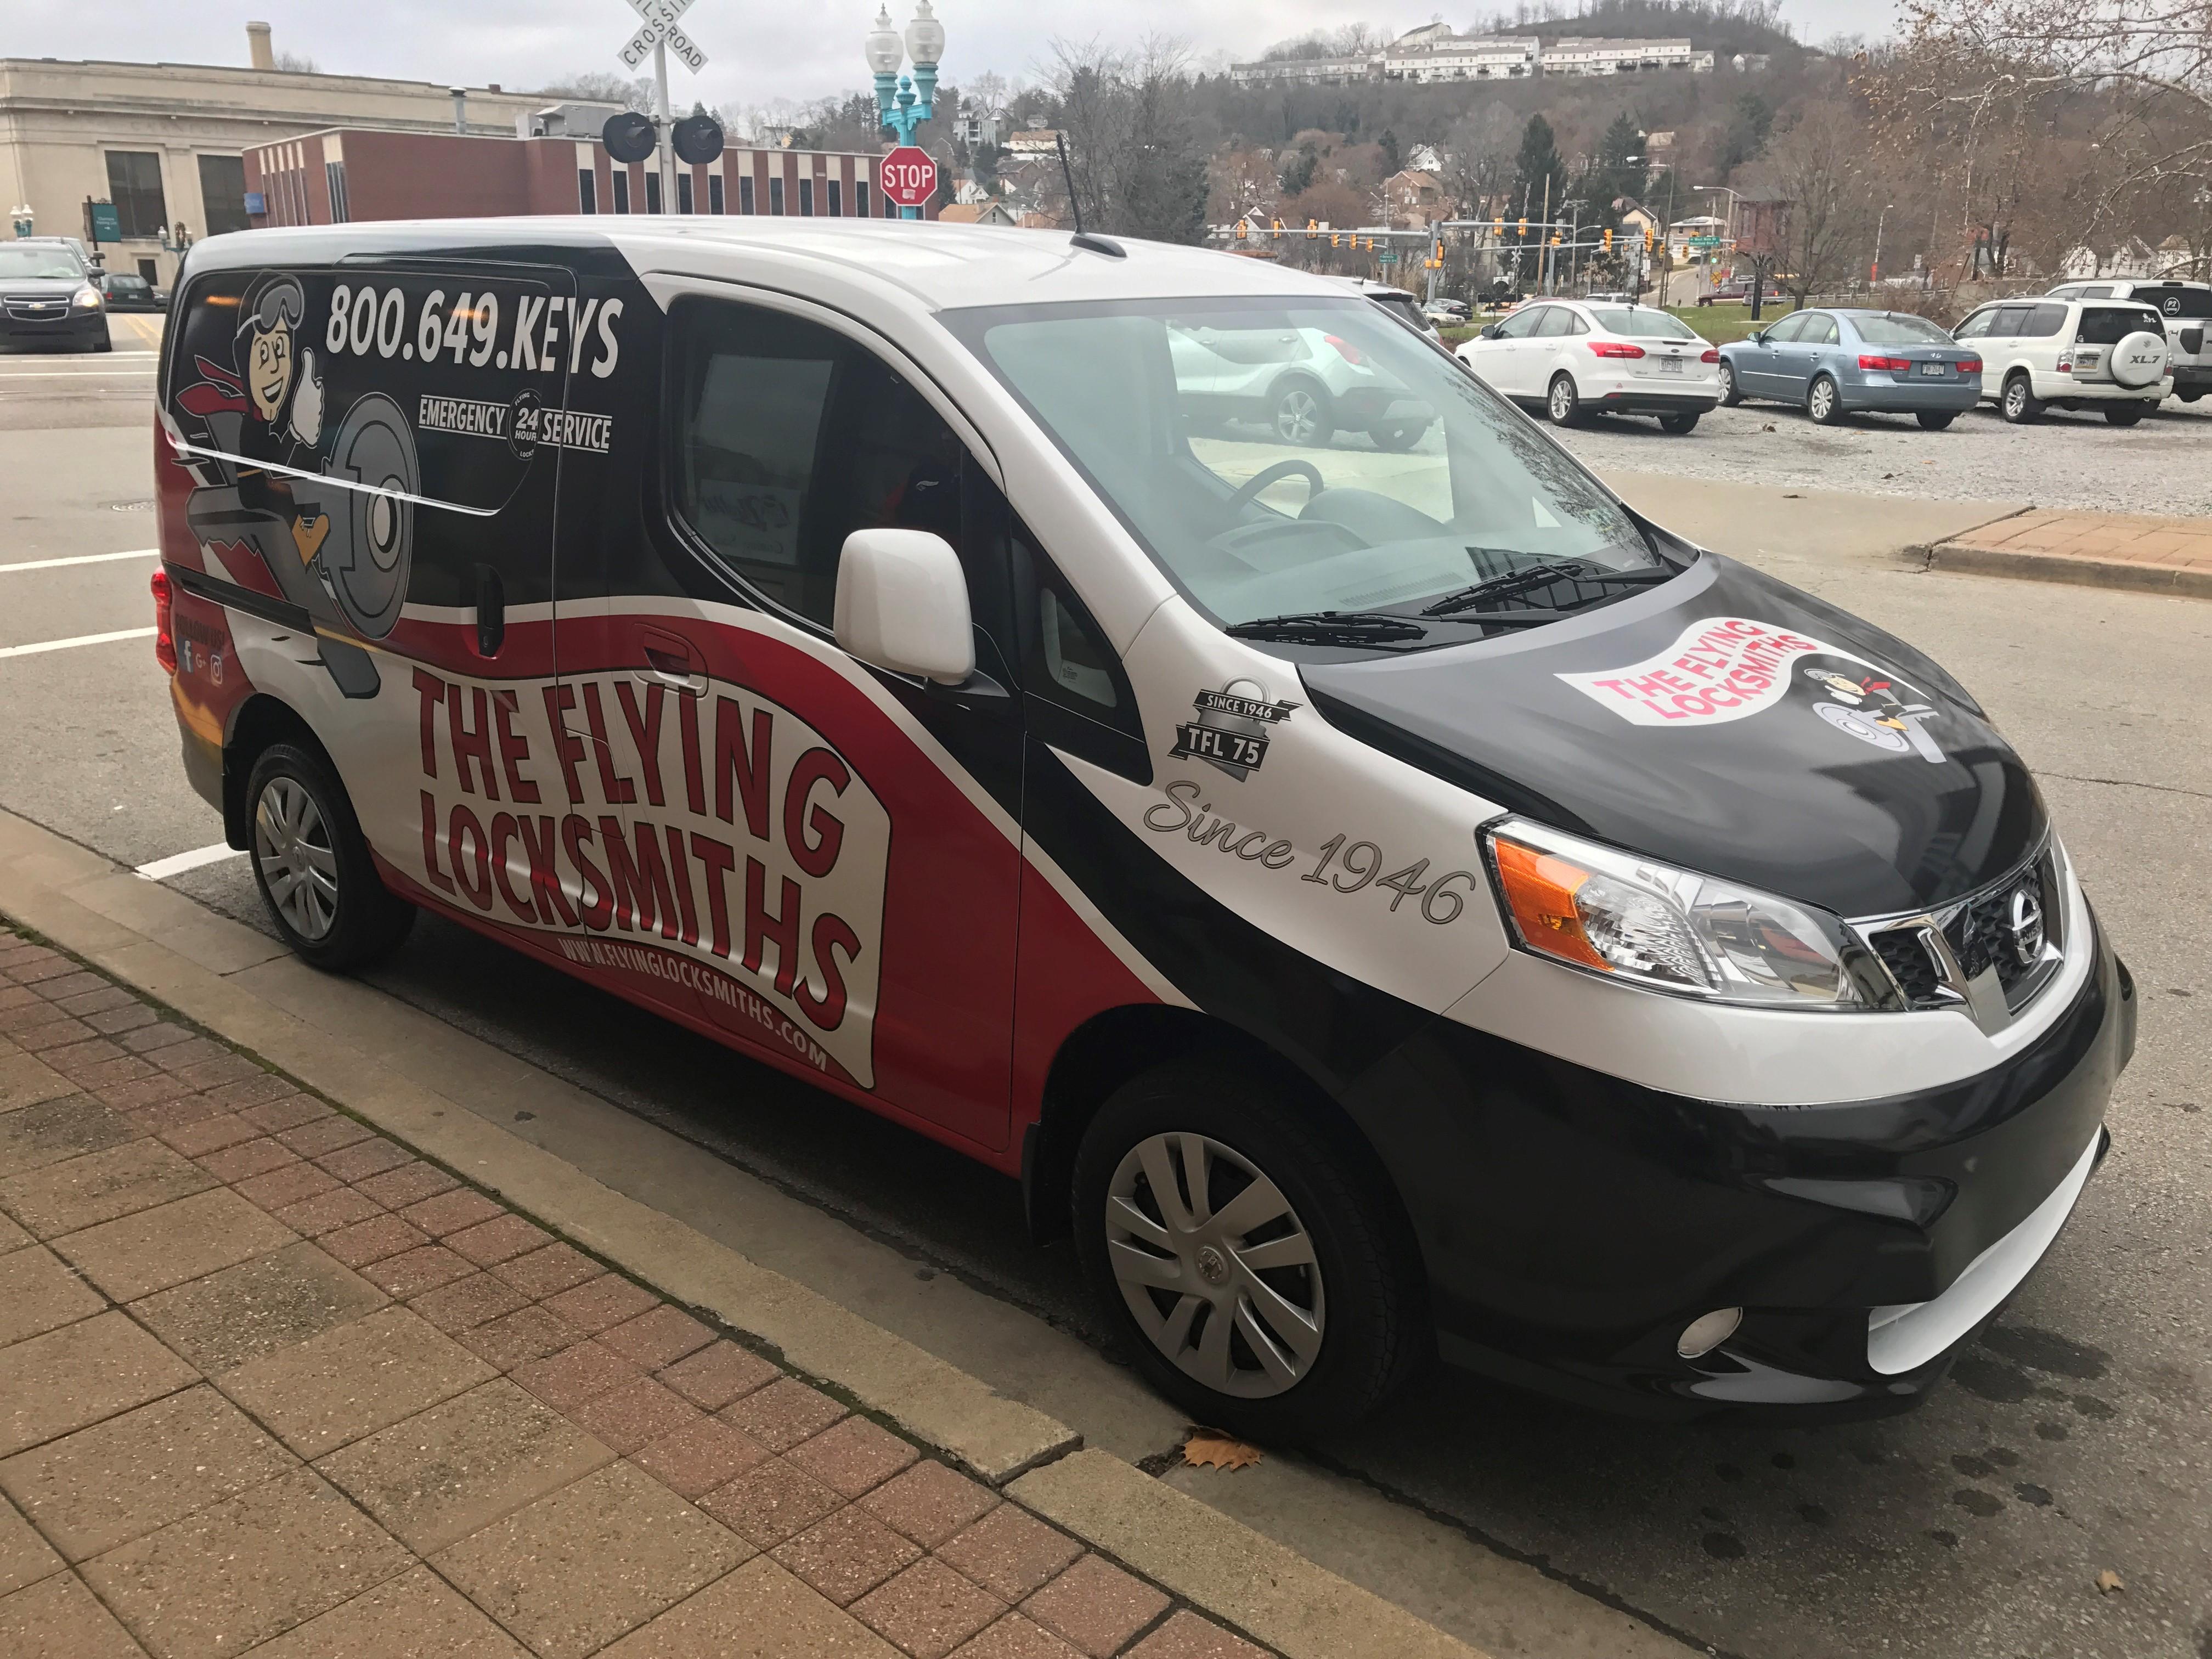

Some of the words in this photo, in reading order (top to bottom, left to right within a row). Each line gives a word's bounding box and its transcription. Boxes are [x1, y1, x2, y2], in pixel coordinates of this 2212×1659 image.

[665, 26, 702, 66] ROAD
[884, 165, 933, 188] STOP
[326, 284, 624, 378] 800.649.KEYS
[419, 398, 506, 435] EMERGENCY
[515, 392, 530, 407] FLYING
[515, 430, 537, 441] HOUR
[516, 407, 539, 431] 24
[543, 412, 612, 449] SERVICE
[1591, 669, 1698, 700] THE
[1672, 620, 1768, 680] FLYING
[1640, 635, 1819, 720] LOCKSMITHS
[1207, 695, 1240, 712] SINCE
[1244, 702, 1272, 719] 1946
[1188, 727, 1223, 757] TFL
[1232, 738, 1260, 764] 75
[412, 666, 542, 804] THE
[541, 680, 851, 879] FLYING
[1143, 780, 1295, 870] Since
[1301, 833, 1476, 925] 1946
[420, 788, 862, 1032] LOCKSMITHS
[557, 938, 827, 1071] WWW.FLYINGLOCKSMITHS.COM
